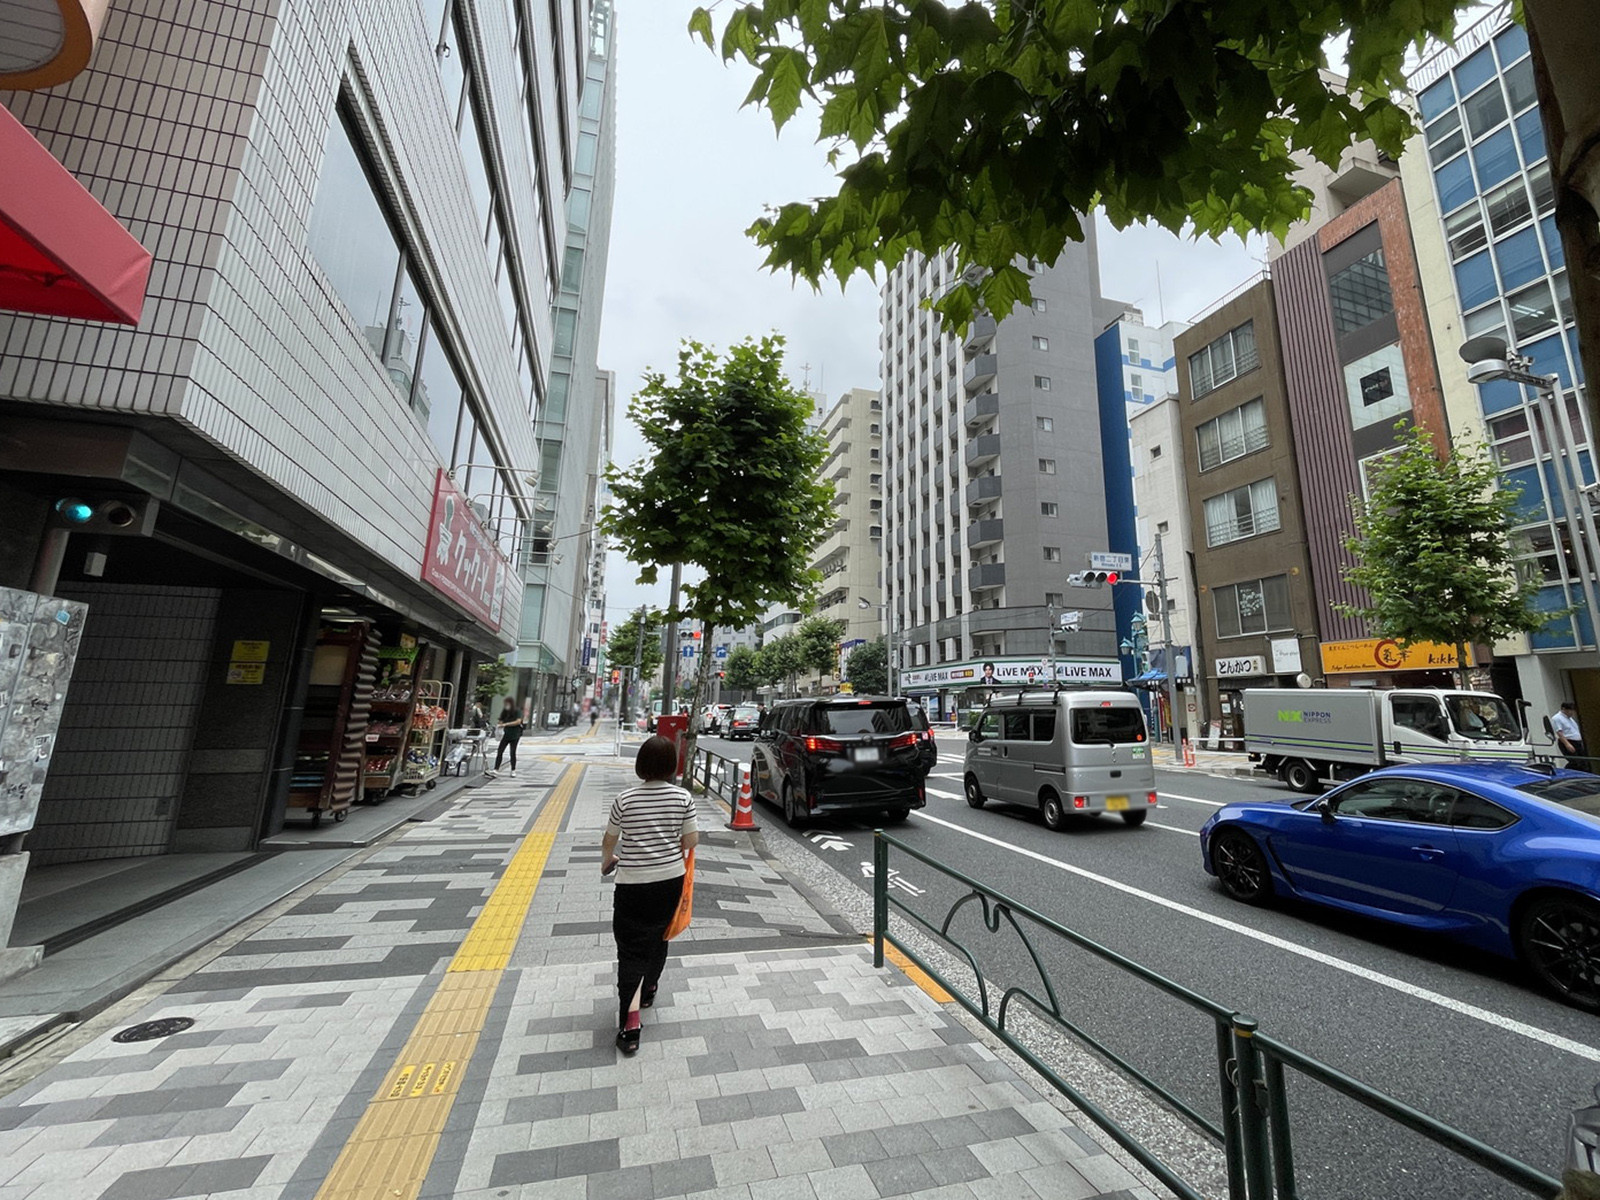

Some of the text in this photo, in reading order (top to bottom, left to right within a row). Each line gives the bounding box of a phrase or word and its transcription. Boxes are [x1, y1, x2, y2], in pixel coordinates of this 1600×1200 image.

[1427, 653, 1458, 664] kikk
[1089, 667, 1112, 677] MAX
[1218, 660, 1252, 674] とんかつ
